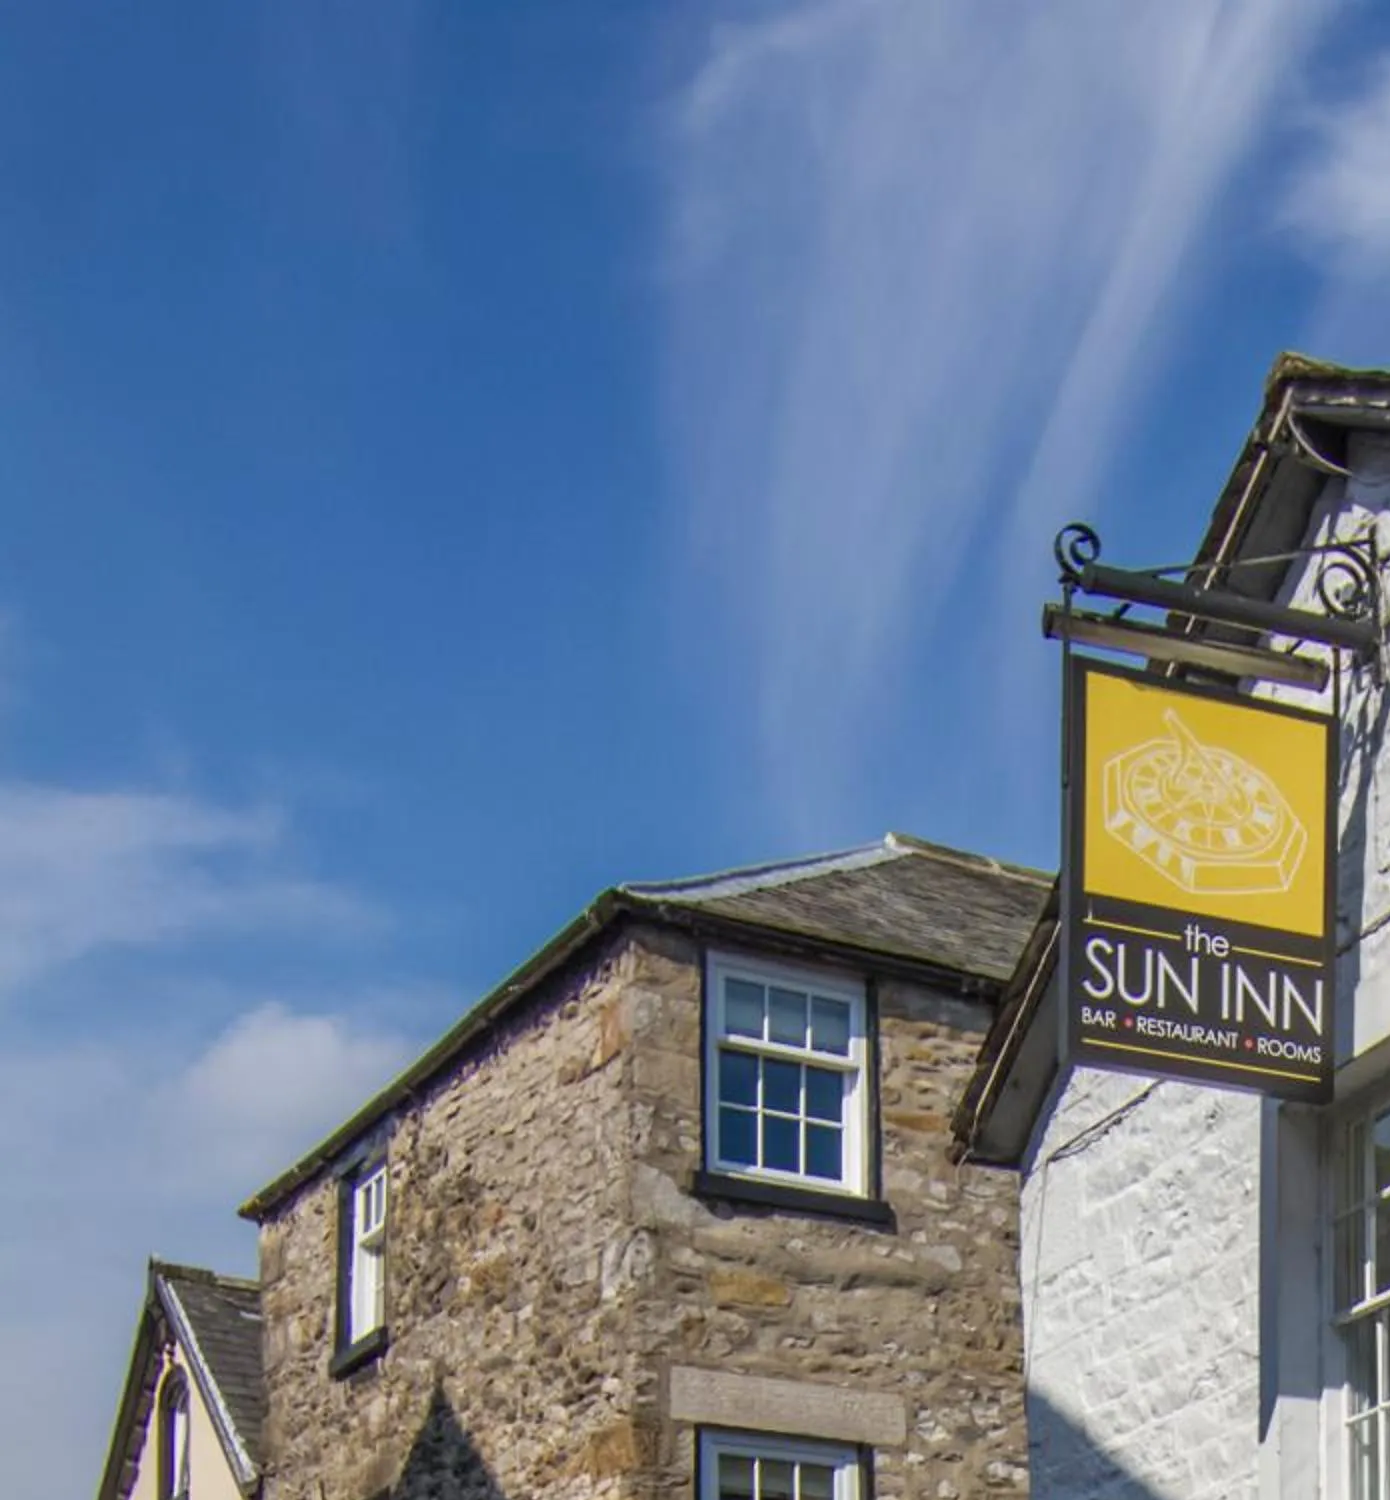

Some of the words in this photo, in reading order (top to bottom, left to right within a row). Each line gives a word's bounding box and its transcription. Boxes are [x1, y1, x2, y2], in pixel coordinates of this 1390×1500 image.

[1184, 924, 1230, 958] the
[1082, 937, 1199, 1016] SUN
[1221, 961, 1324, 1036] INN
[1081, 1006, 1117, 1030] BAR
[1136, 1015, 1239, 1050] RESTAURANT
[1256, 1037, 1322, 1065] ROOMS
